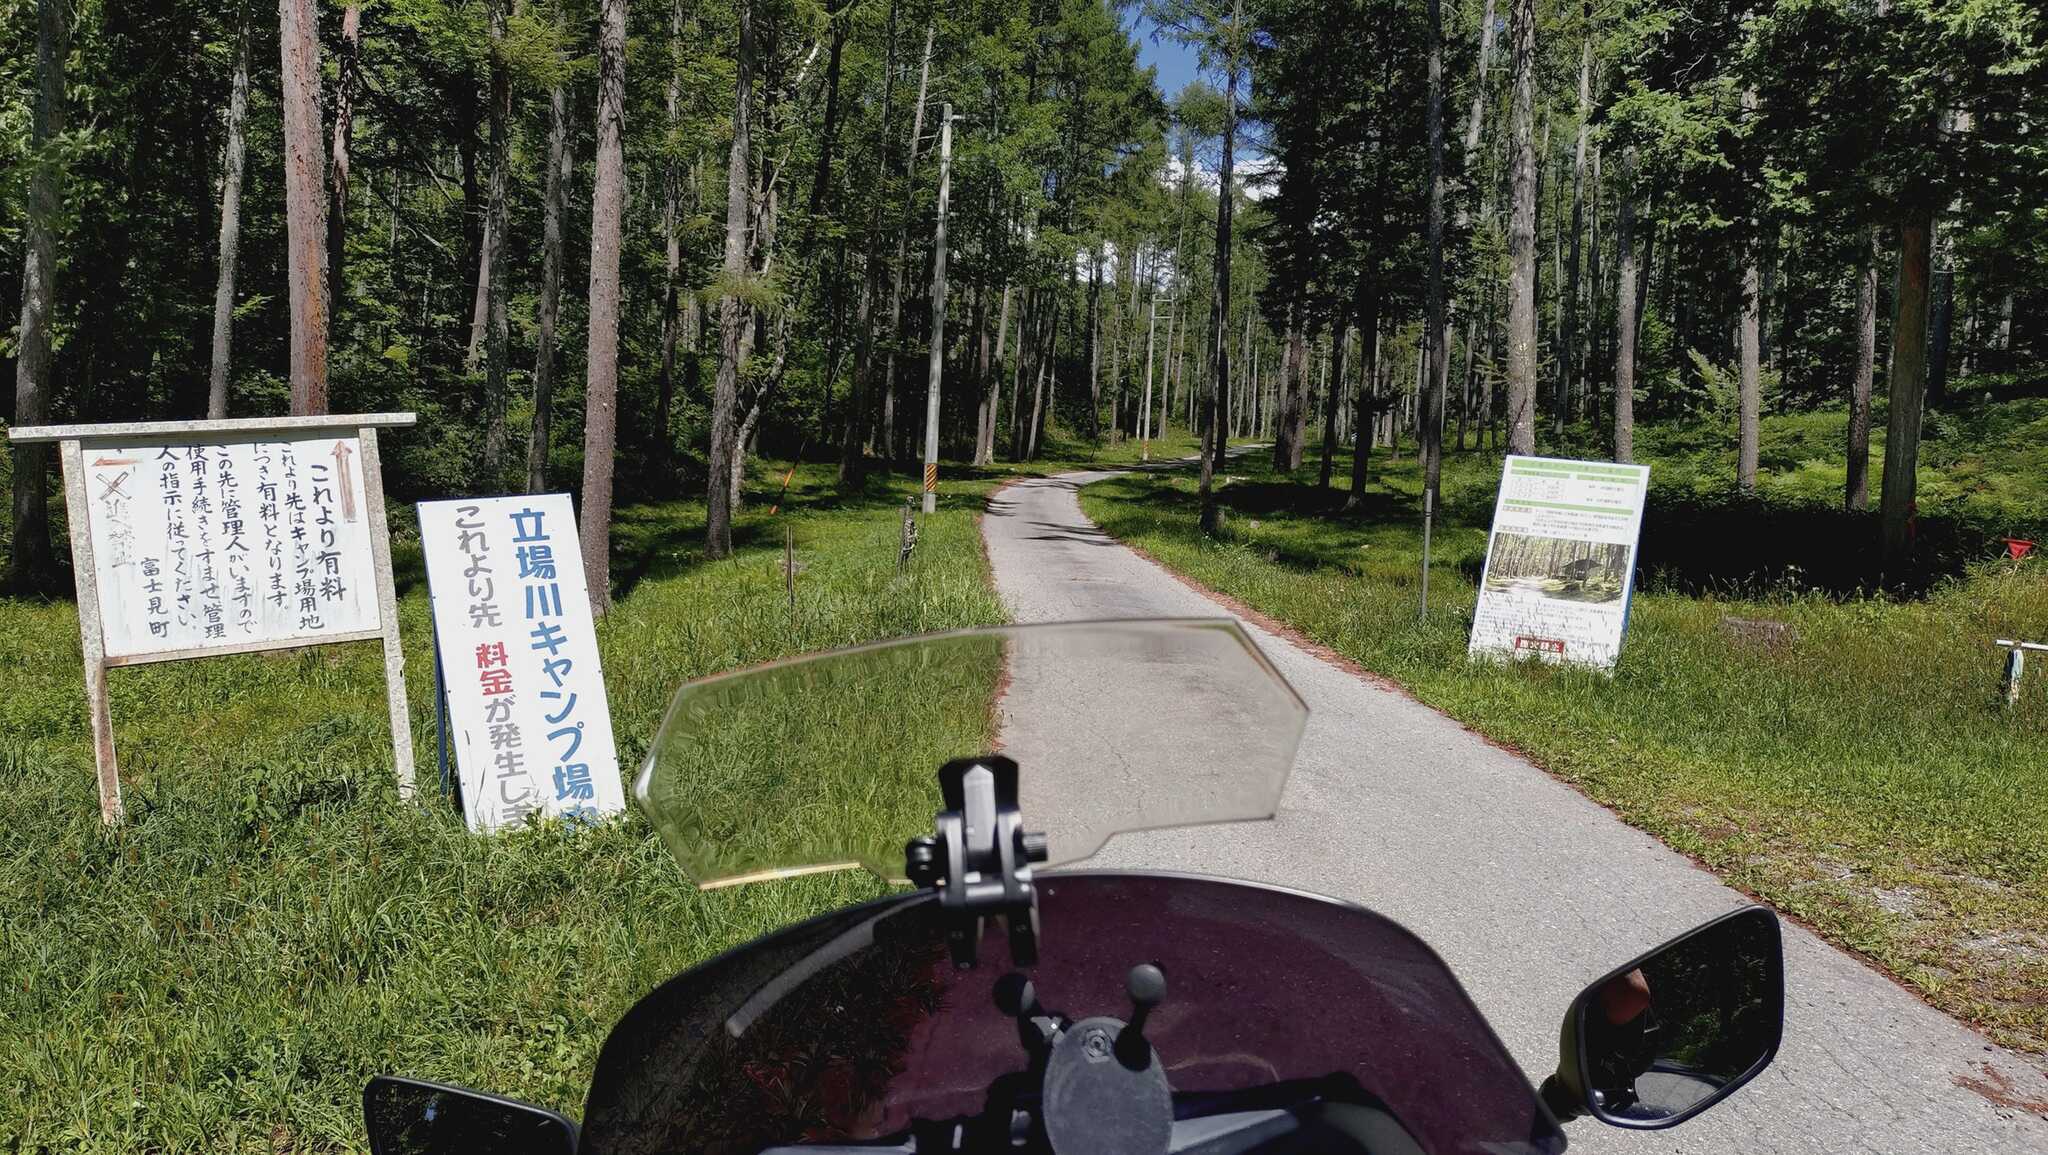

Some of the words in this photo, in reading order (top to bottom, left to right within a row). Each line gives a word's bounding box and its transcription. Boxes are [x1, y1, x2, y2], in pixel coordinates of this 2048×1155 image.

[311, 464, 347, 601] これより有料
[455, 505, 503, 629] これより先
[141, 557, 170, 639] 富士見町
